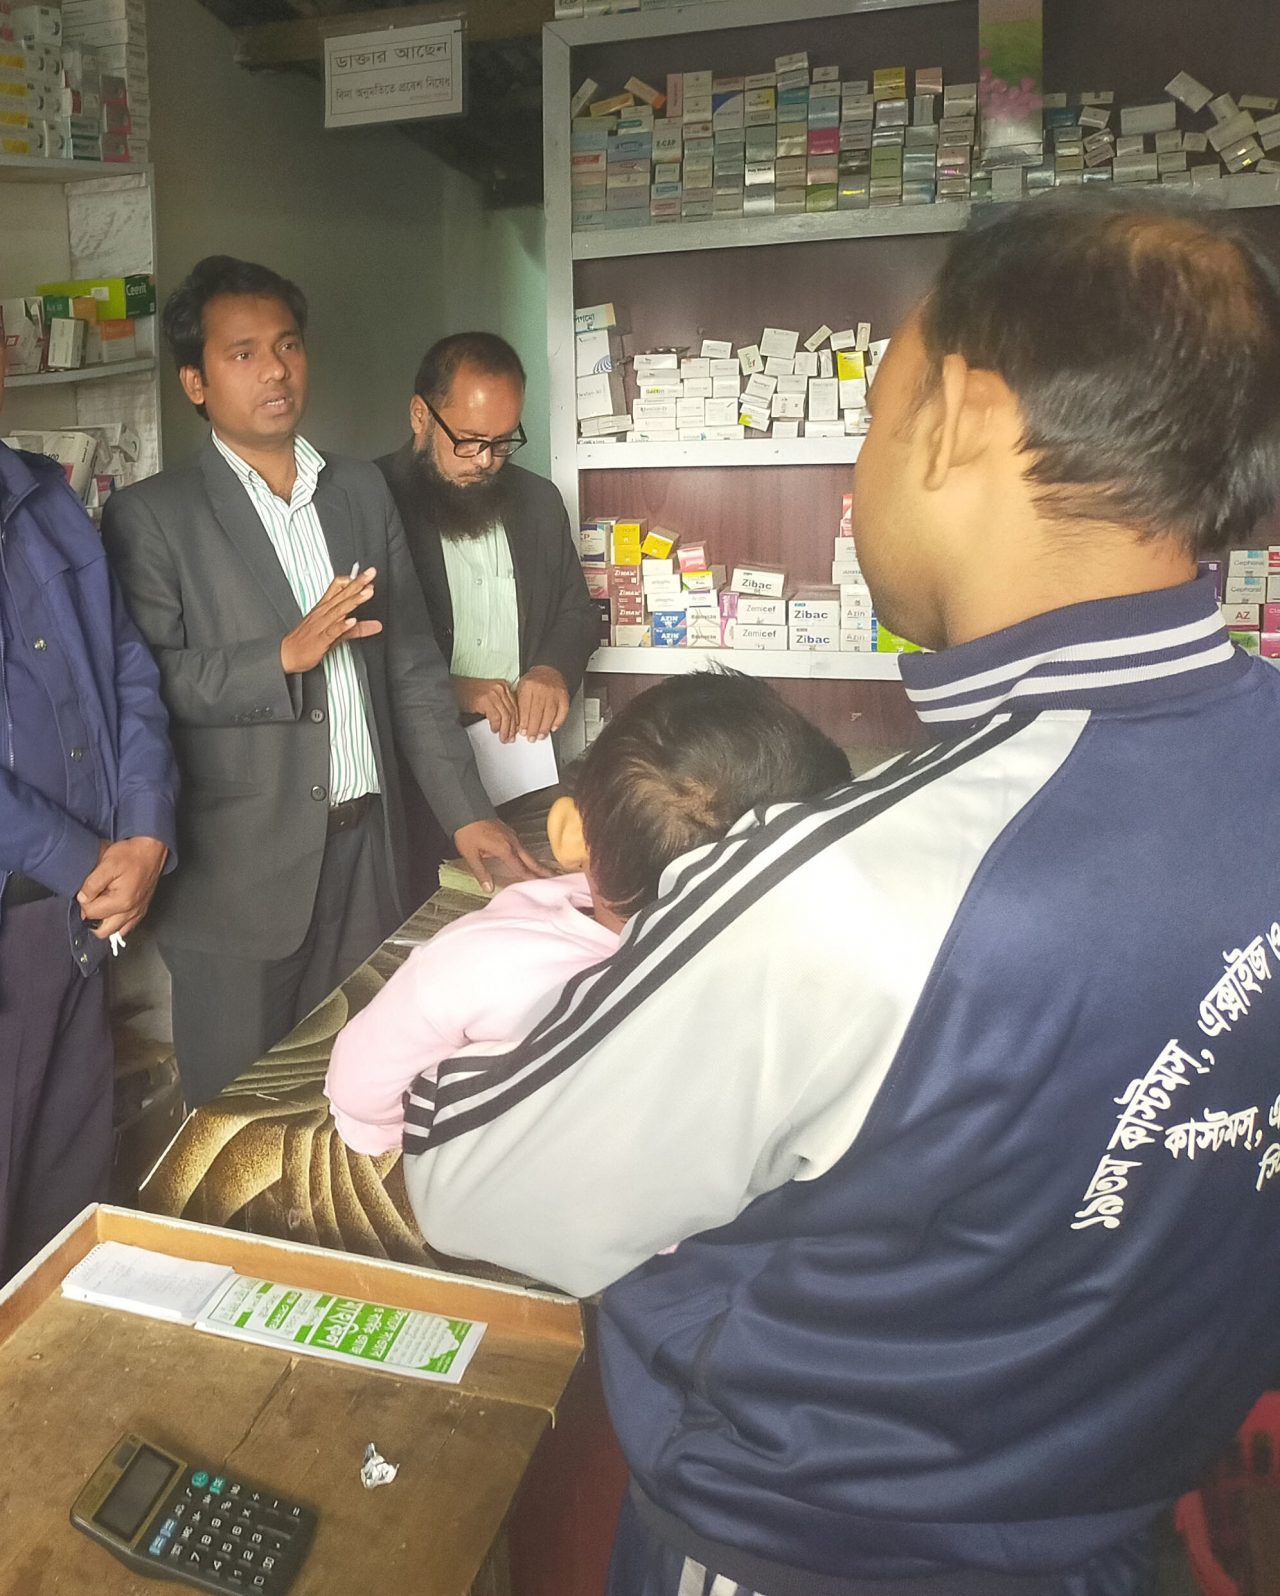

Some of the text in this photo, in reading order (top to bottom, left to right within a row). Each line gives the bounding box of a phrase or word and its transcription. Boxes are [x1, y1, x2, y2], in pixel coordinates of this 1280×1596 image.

[335, 42, 448, 68] ডাক্তার আছেন
[742, 578, 772, 590] Zibac
[746, 605, 776, 613] Zemicef
[794, 610, 829, 620] Zibac
[847, 609, 865, 617] Azin
[742, 629, 777, 638] Zemicef
[796, 635, 830, 645] Zibac
[1070, 1154, 1142, 1230] ১৯তম
[1198, 935, 1271, 1037] এক্সাইজ
[317, 1302, 364, 1348] মাহফিল
[190, 1552, 200, 1563] 7
[201, 1535, 212, 1545] 8
[211, 1518, 222, 1528] 9
[213, 1525, 242, 1570] 4 5 6
[243, 1550, 254, 1561] 2
[252, 1533, 262, 1544] 3
[253, 1575, 265, 1587] 0
